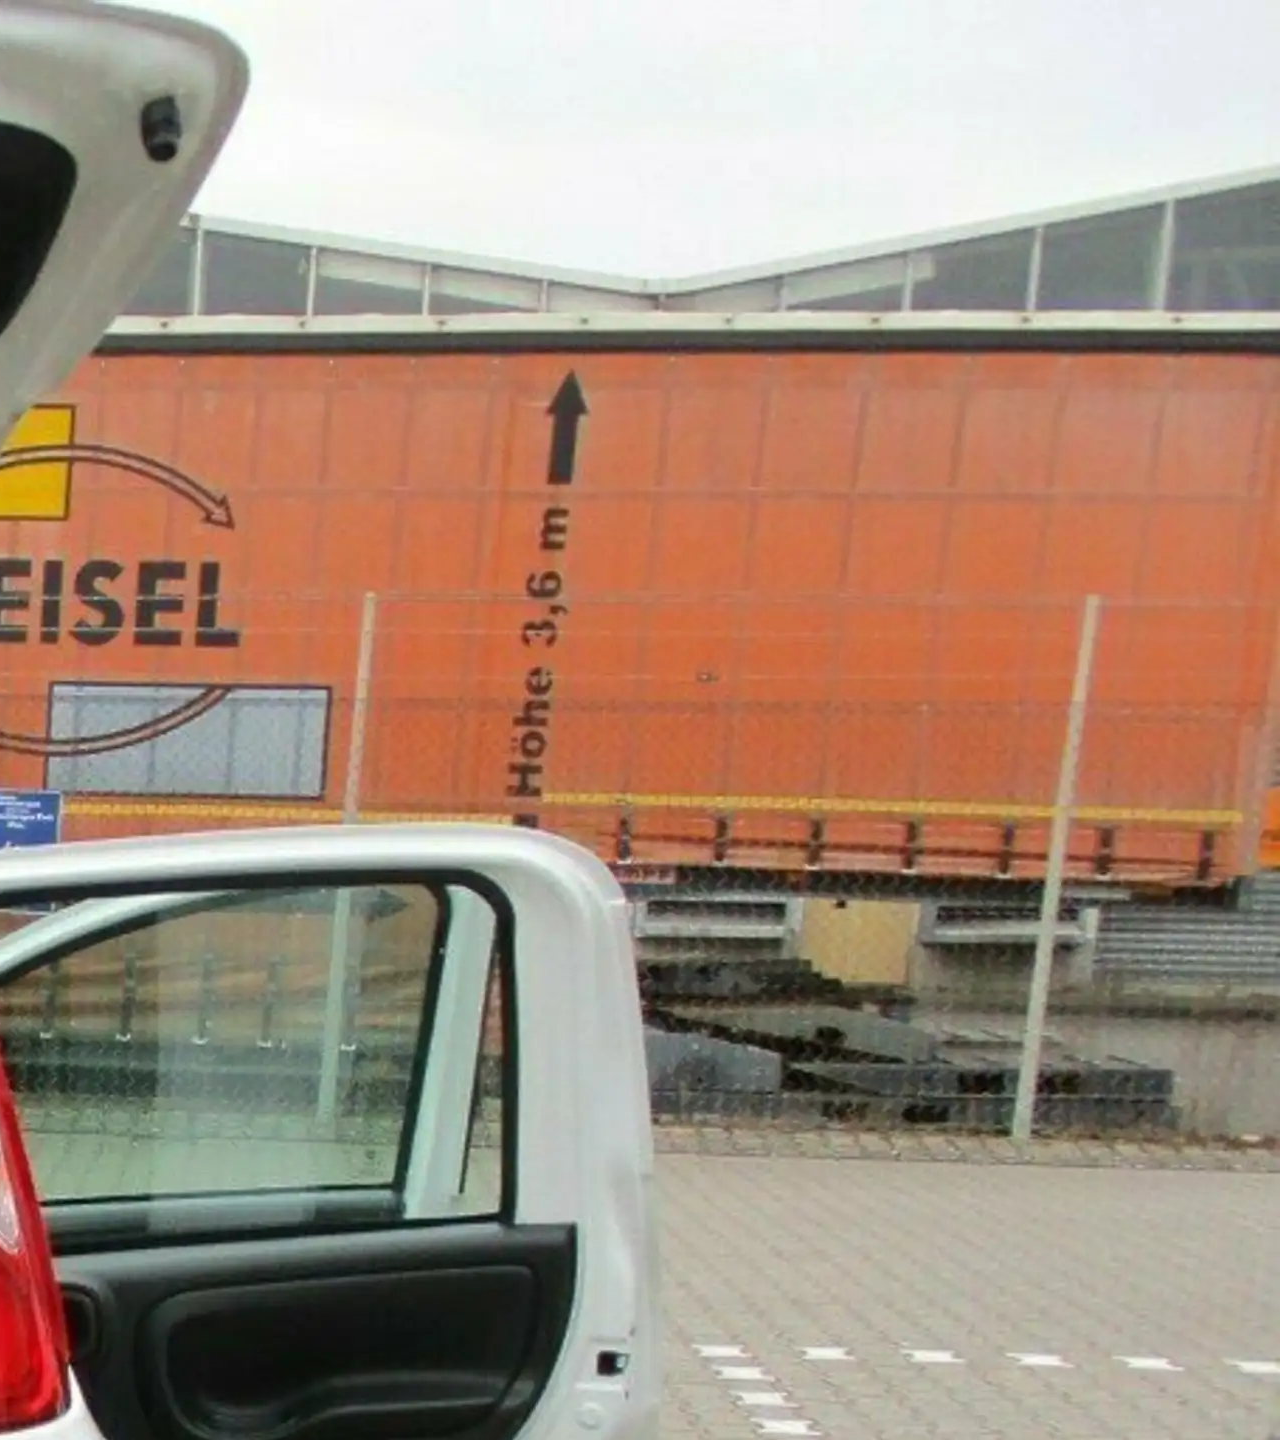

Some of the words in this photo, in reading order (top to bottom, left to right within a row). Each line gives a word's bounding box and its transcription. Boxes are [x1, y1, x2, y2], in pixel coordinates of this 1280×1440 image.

[539, 506, 570, 550] m
[521, 570, 568, 649] 3,6
[507, 666, 553, 797] Höhe
